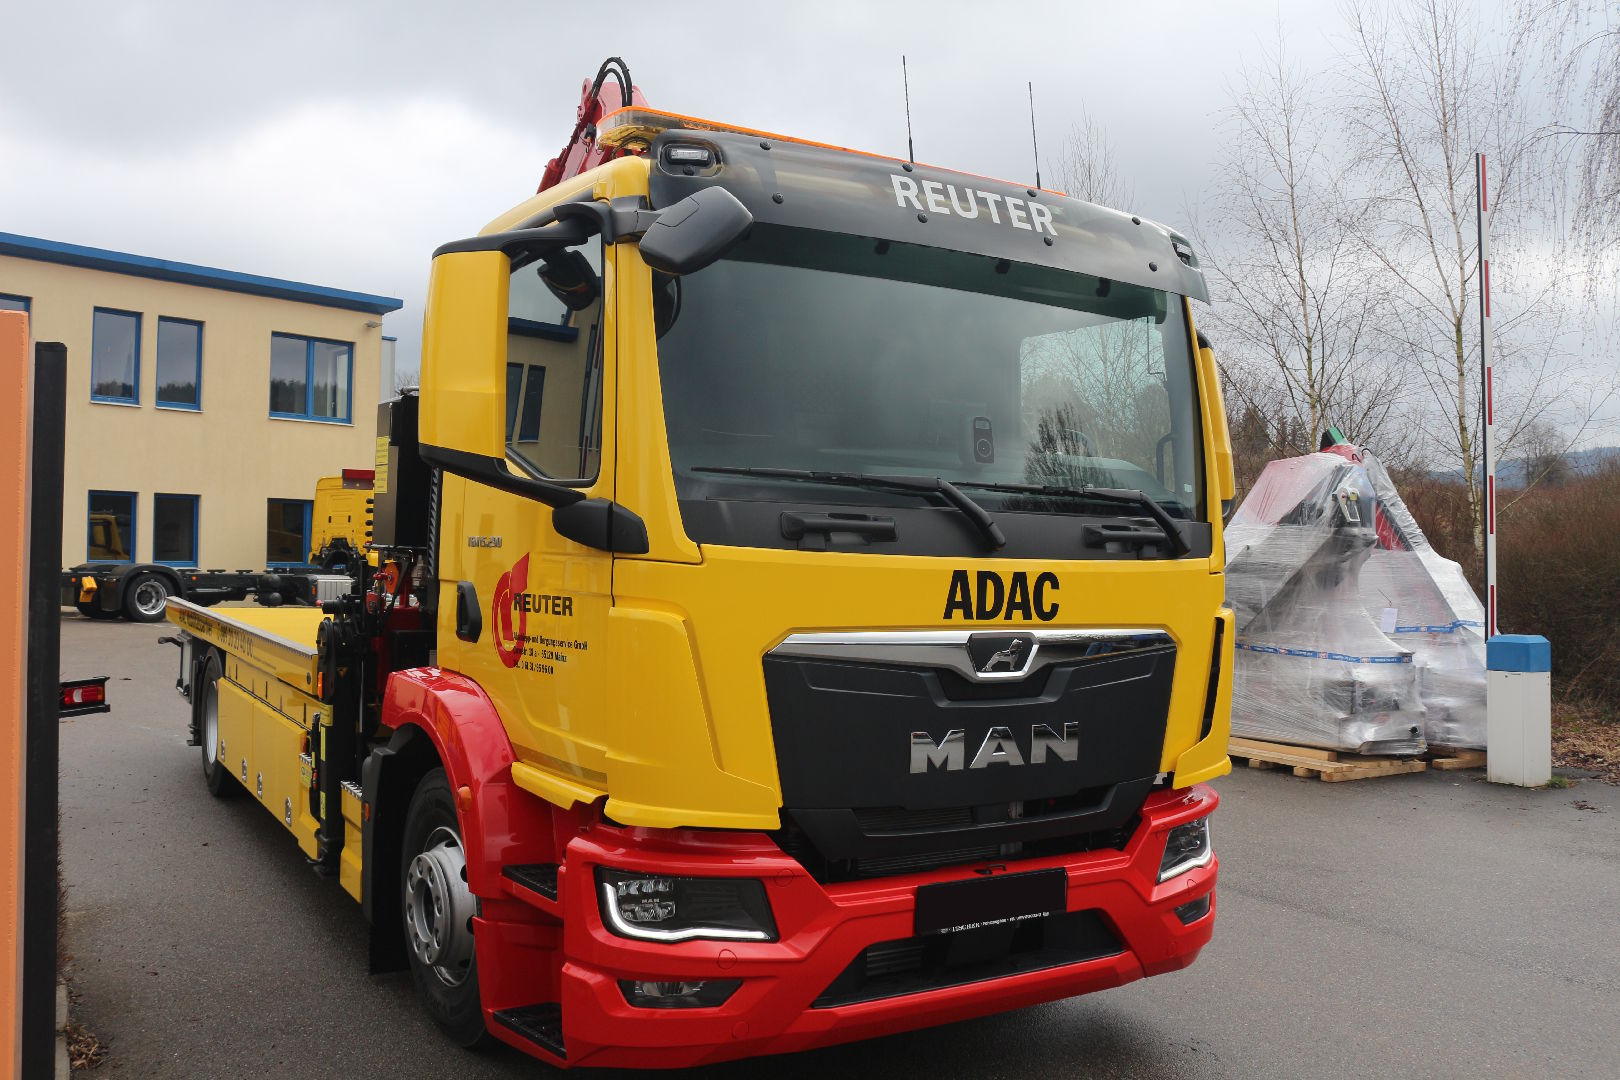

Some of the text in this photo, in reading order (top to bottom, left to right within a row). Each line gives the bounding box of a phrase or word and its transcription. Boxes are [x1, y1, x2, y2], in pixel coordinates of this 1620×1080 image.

[890, 174, 1058, 236] REUTER
[513, 593, 573, 617] REUTER
[943, 569, 1060, 622] ADAC
[574, 640, 588, 650] GmbH
[909, 721, 1079, 774] MAN
